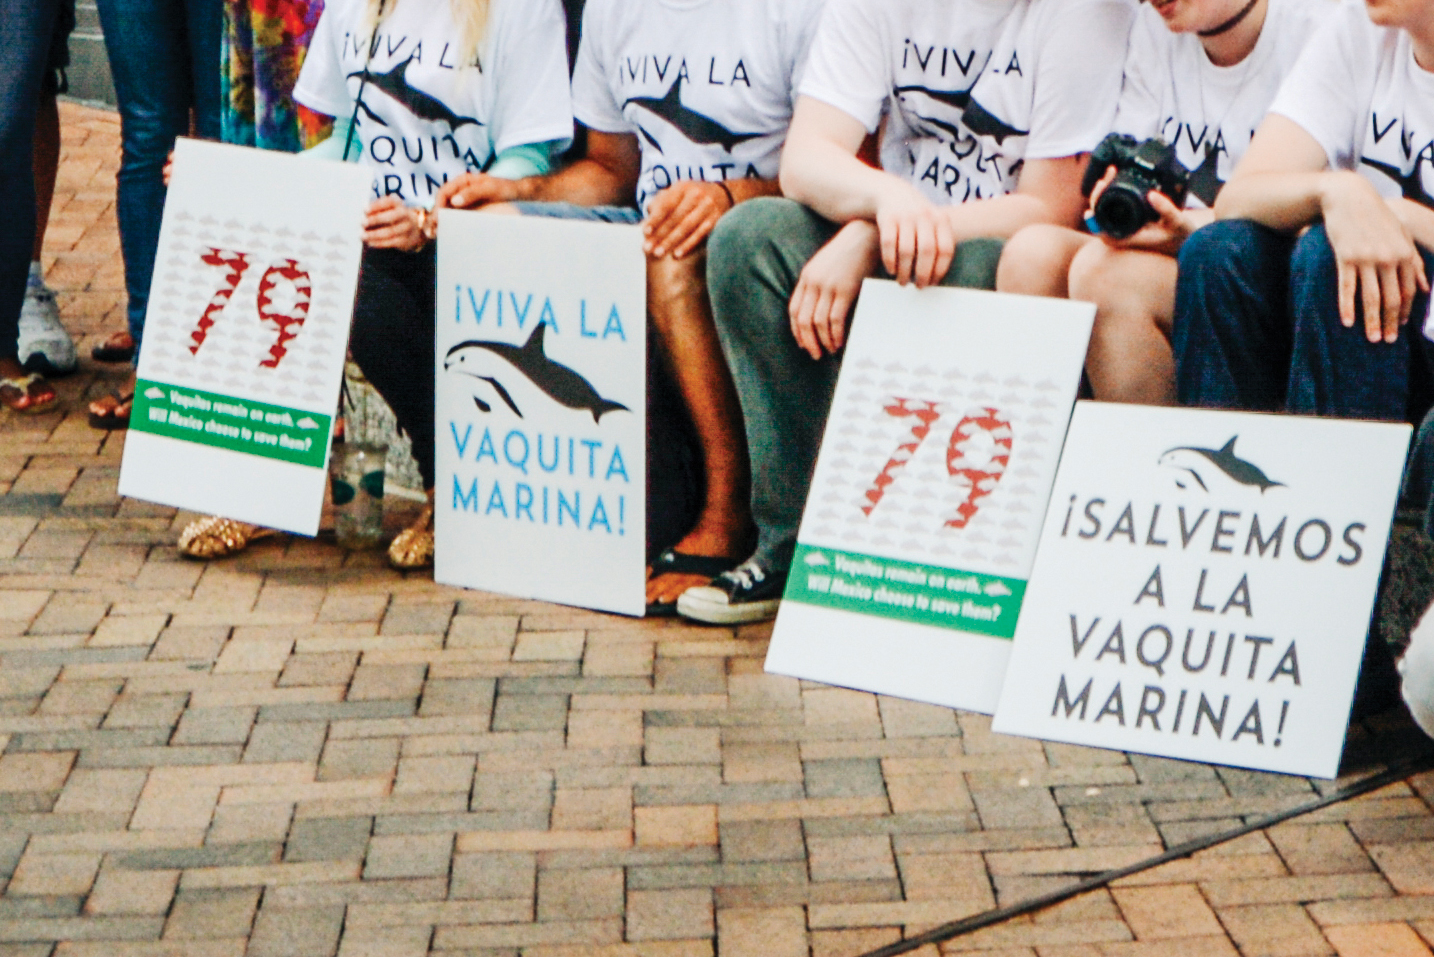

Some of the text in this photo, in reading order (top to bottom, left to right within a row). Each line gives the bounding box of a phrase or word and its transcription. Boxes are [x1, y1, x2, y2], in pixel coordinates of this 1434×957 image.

[708, 55, 752, 88] LA
[903, 38, 993, 78] ¡VIV
[369, 133, 483, 175] QUITA
[187, 245, 313, 370] 79
[454, 284, 627, 343] ¡VIVA LA
[450, 420, 630, 483] VAQUITA
[860, 395, 1014, 530] 79
[453, 471, 626, 537] MARINA!
[1060, 493, 1368, 567] ¡SALVEMOS
[1133, 562, 1254, 618] A LA
[1069, 613, 1302, 687] VAQUITA
[1051, 672, 1291, 748] MARINA!
